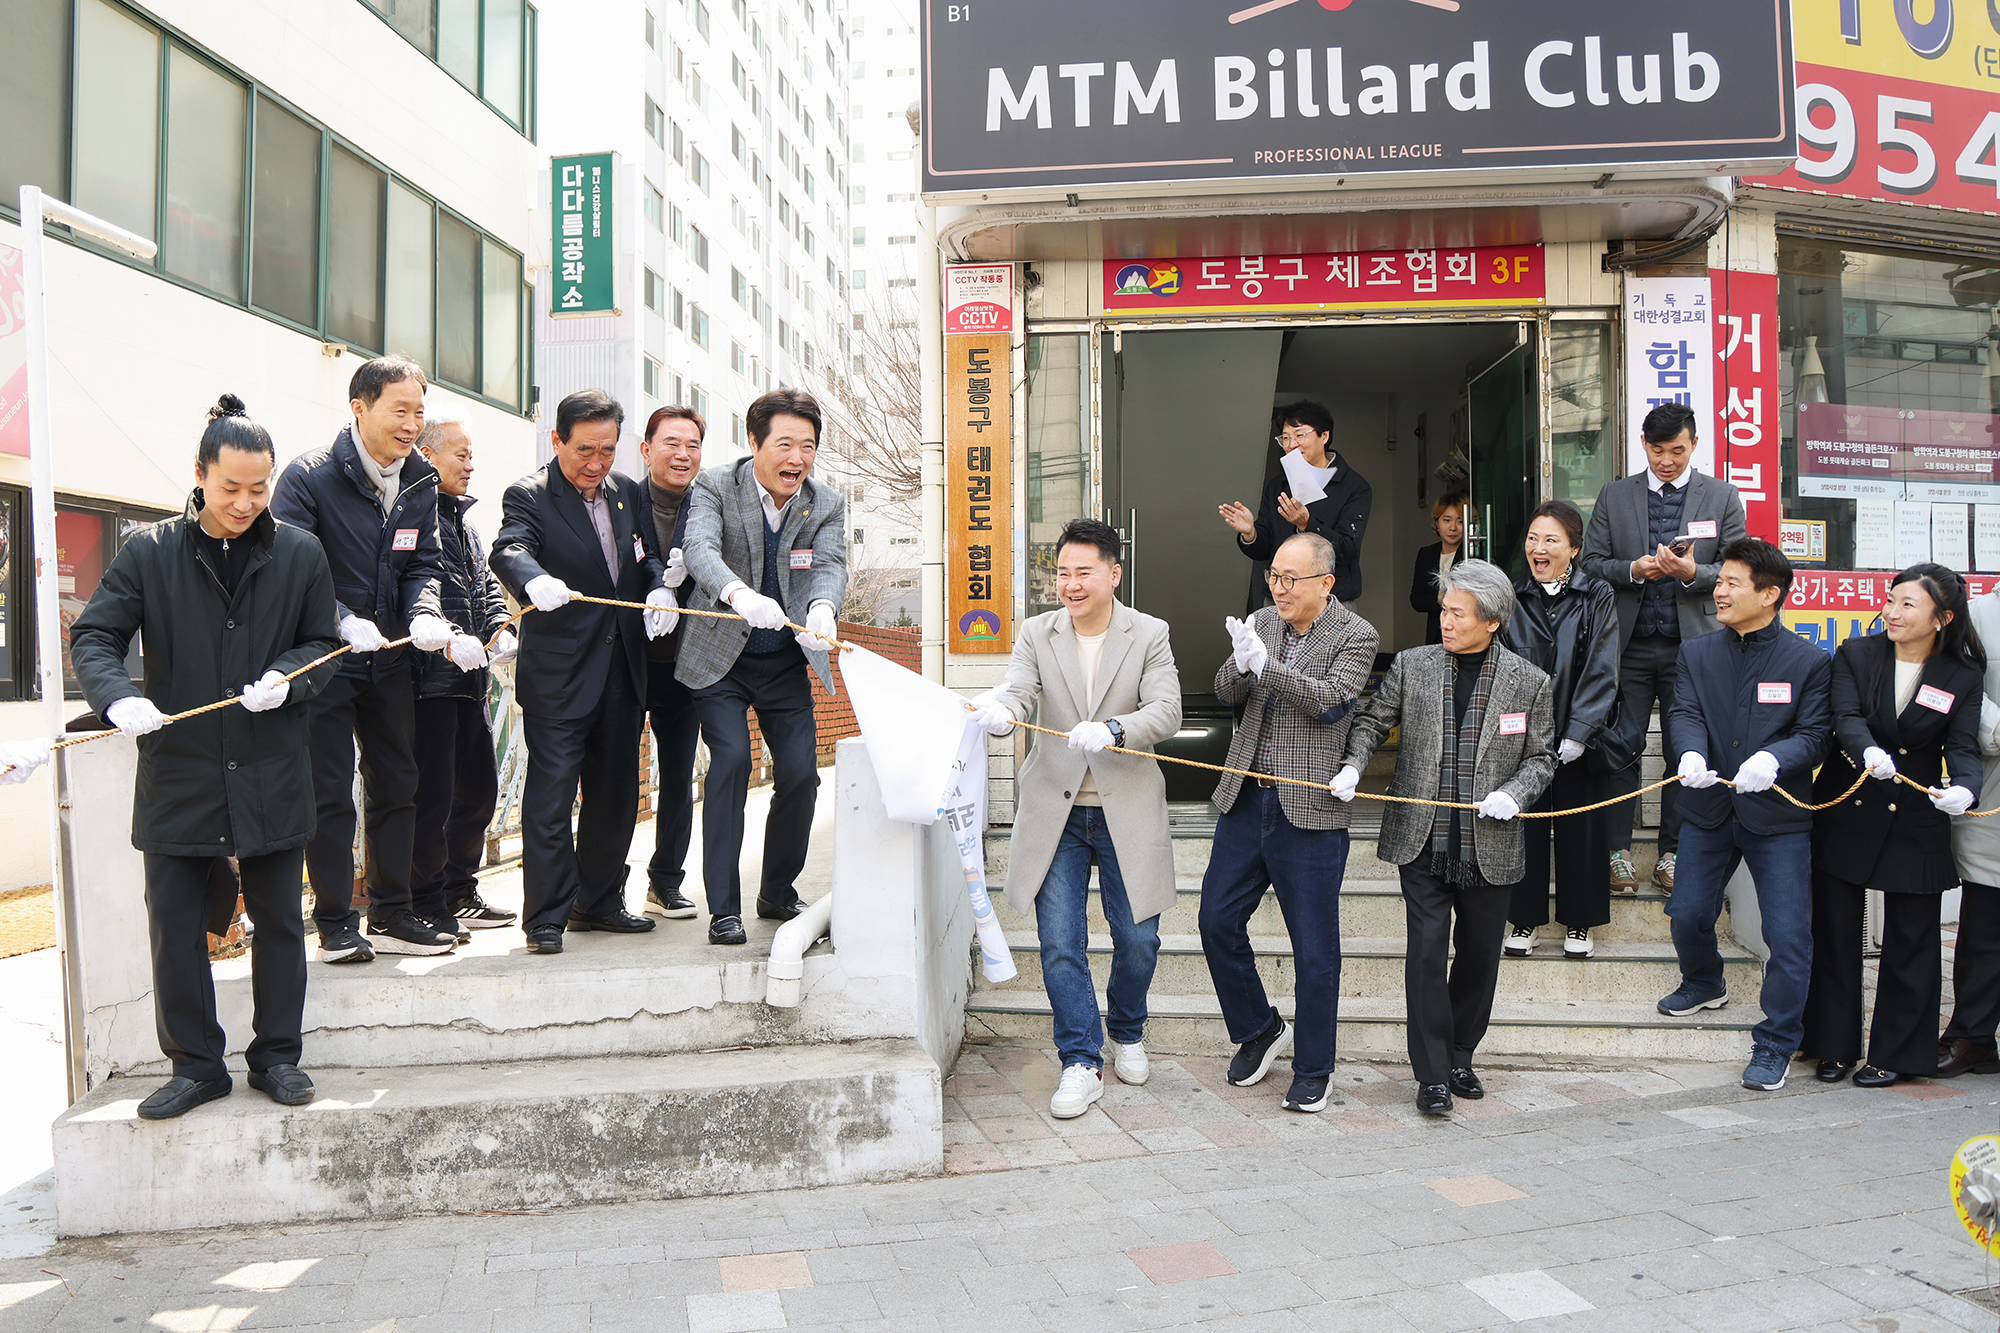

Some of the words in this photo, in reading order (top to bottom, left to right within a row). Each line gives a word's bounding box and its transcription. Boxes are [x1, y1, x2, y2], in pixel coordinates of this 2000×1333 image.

[948, 5, 970, 22] B1
[986, 58, 1181, 132] MTM
[1214, 40, 1491, 121] Billard
[1524, 32, 1721, 109] Club
[1254, 147, 1375, 164] PROFESSIONAL
[1380, 143, 1442, 159] LEAGUE
[561, 164, 585, 308] 다다름공작소
[955, 276, 978, 284] CCTV
[980, 275, 1003, 284] 작동중
[1196, 256, 1309, 298] 도봉구
[1325, 249, 1476, 293] 체조협회
[1491, 256, 1530, 284] 3F
[959, 311, 999, 325] CCTV
[1633, 310, 1706, 324] 대한성결교회
[967, 348, 991, 433] 도봉구
[1717, 313, 1766, 541] 거성부
[1806, 440, 1832, 451] 방학역과
[1833, 442, 1864, 453] 도봉구청의
[967, 446, 992, 531] 태권도
[967, 544, 992, 601] 협회
[1789, 576, 1892, 606] 상가.주택.
